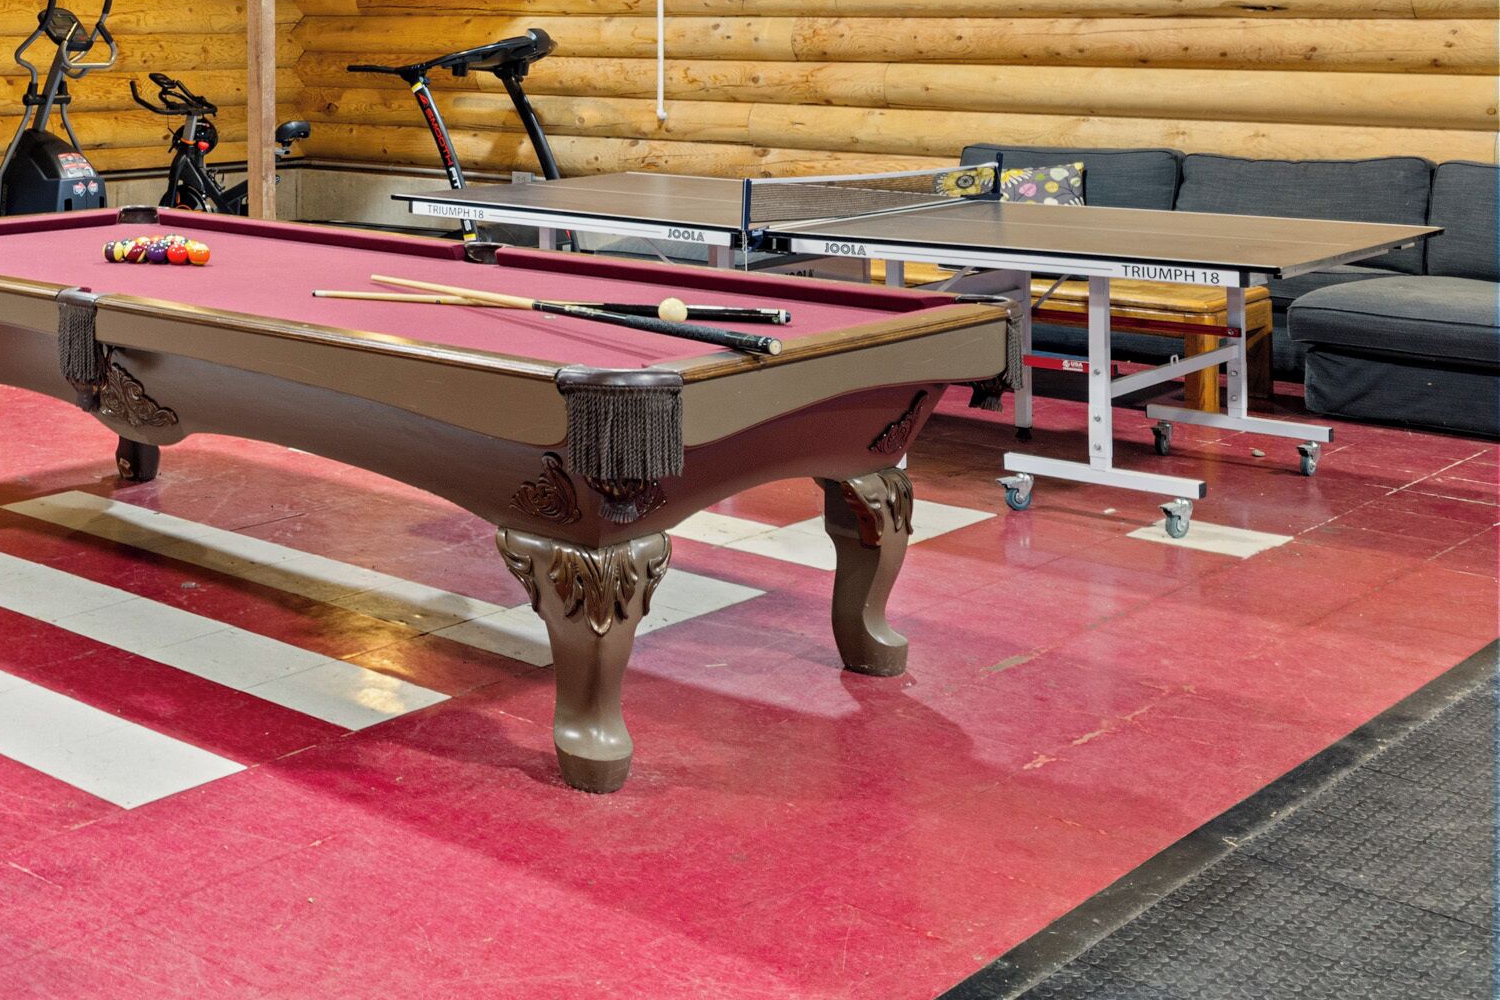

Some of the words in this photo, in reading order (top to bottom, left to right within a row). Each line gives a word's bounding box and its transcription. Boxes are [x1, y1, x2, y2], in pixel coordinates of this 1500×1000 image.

[425, 108, 454, 167] SMOOTH
[428, 205, 470, 217] TRIUMPH
[473, 209, 484, 218] 18
[668, 229, 705, 242] JOOLA
[825, 243, 867, 256] JOOLA
[1121, 264, 1195, 282] TRIUMPH
[1202, 272, 1220, 284] 18
